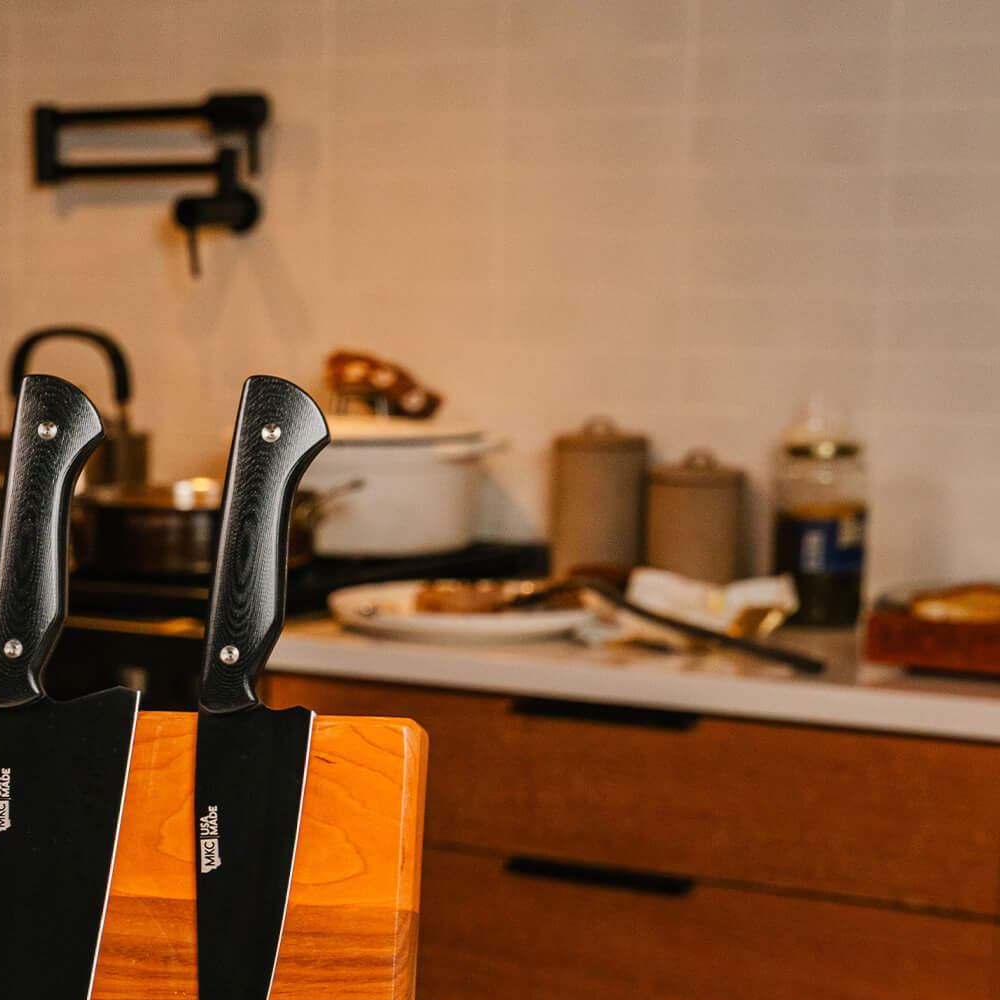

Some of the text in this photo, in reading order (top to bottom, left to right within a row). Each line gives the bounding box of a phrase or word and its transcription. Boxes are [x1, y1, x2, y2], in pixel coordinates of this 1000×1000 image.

[1, 768, 11, 797] MADE
[200, 816, 209, 836] USA
[208, 805, 218, 836] MADE
[204, 841, 215, 866] MKC
